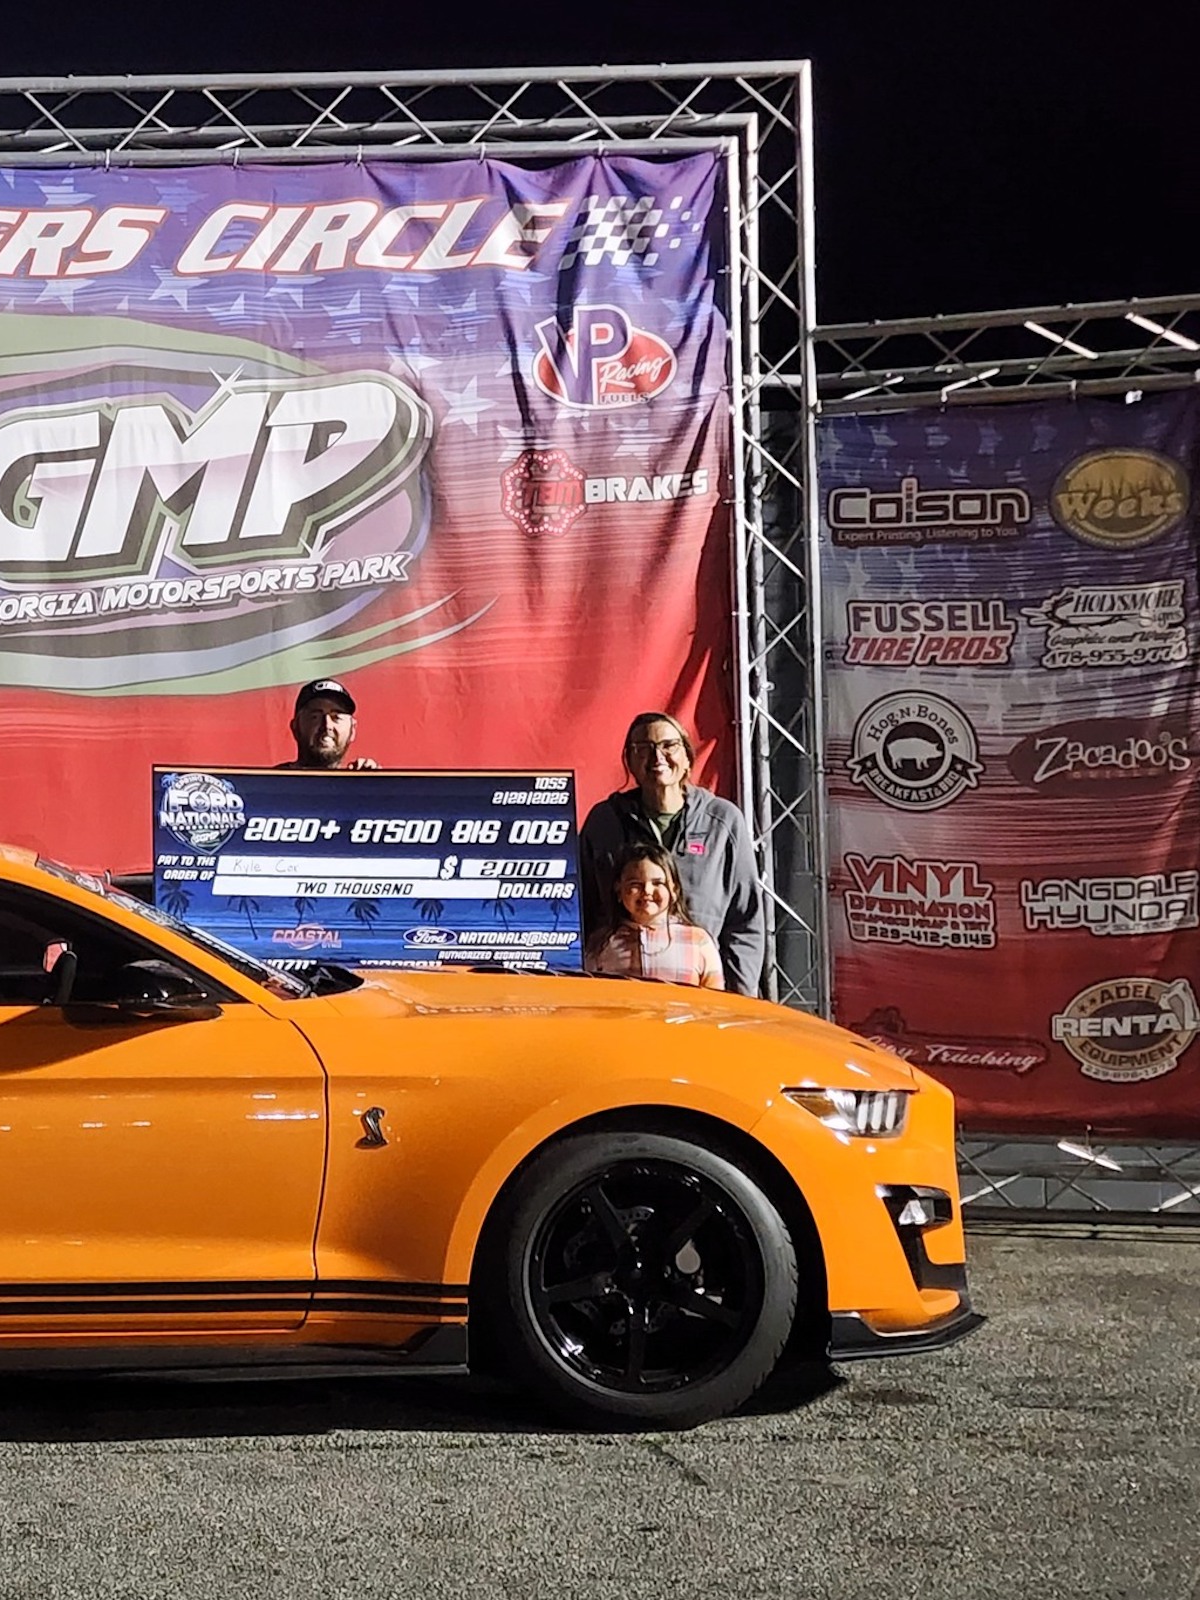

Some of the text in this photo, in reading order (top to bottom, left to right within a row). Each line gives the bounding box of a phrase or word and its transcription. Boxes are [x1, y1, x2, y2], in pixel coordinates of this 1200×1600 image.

[176, 199, 571, 275] CIRCLE
[535, 304, 631, 405] VP
[601, 355, 671, 392] Racing
[601, 392, 651, 404] FUELS
[585, 470, 709, 504] BRAKES
[832, 479, 1028, 525] Colson
[1056, 489, 1183, 520] Weeks
[838, 531, 874, 542] Expert
[926, 528, 978, 540] Listening
[981, 528, 994, 538] to
[102, 565, 319, 611] MOTORSPORTS
[322, 554, 406, 587] PARK
[852, 604, 1013, 633] FUSSELL
[850, 636, 1010, 662] TIRE PROS
[169, 790, 244, 812] FORD
[160, 811, 246, 828] NATIONALS
[244, 817, 340, 842] 2020+
[350, 819, 443, 843] GT500
[451, 820, 501, 843] BIG
[157, 855, 216, 867] PAY TO THE
[440, 855, 458, 880] $
[163, 870, 215, 881] ORDER OF
[850, 859, 989, 899] VINYL
[1025, 875, 1197, 902] LANGDALE
[296, 882, 414, 896] TWO THOUSAND
[500, 883, 576, 899] DOLLARS
[1029, 896, 1194, 925] HYUNDAI
[272, 929, 342, 943] COASTAL
[413, 927, 447, 943] Ford
[438, 951, 492, 961] AUTHORIZED
[1100, 985, 1156, 1004] ADEL
[1056, 1013, 1200, 1037] RENTAL
[925, 1044, 1045, 1072] Trucking
[1079, 1034, 1182, 1067] EQUIPMENT
